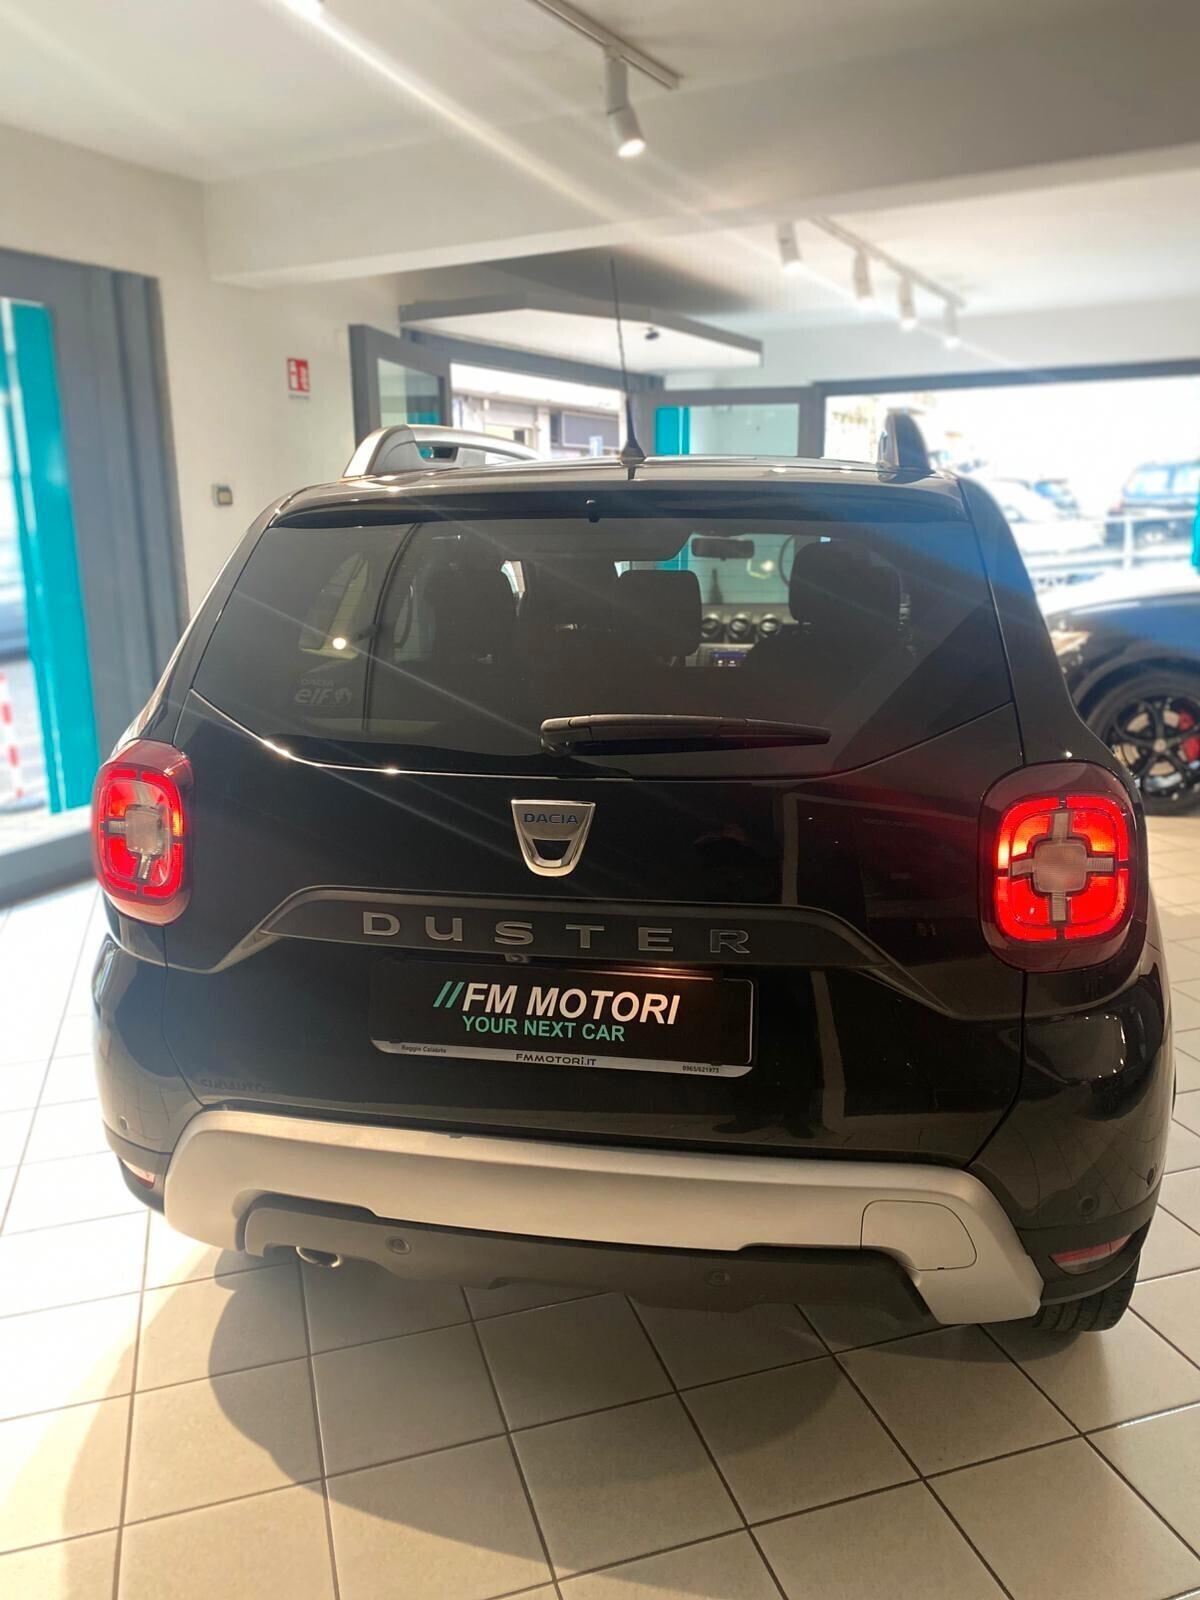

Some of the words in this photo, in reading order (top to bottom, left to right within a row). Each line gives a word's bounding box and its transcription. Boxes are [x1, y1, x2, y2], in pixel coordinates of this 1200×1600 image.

[523, 813, 579, 825] DACIA
[362, 911, 751, 954] DUSTER
[526, 986, 681, 1025] MOTORI
[462, 1015, 518, 1036] YOUR
[523, 1019, 576, 1039] NEXT
[582, 1022, 626, 1043] CAR
